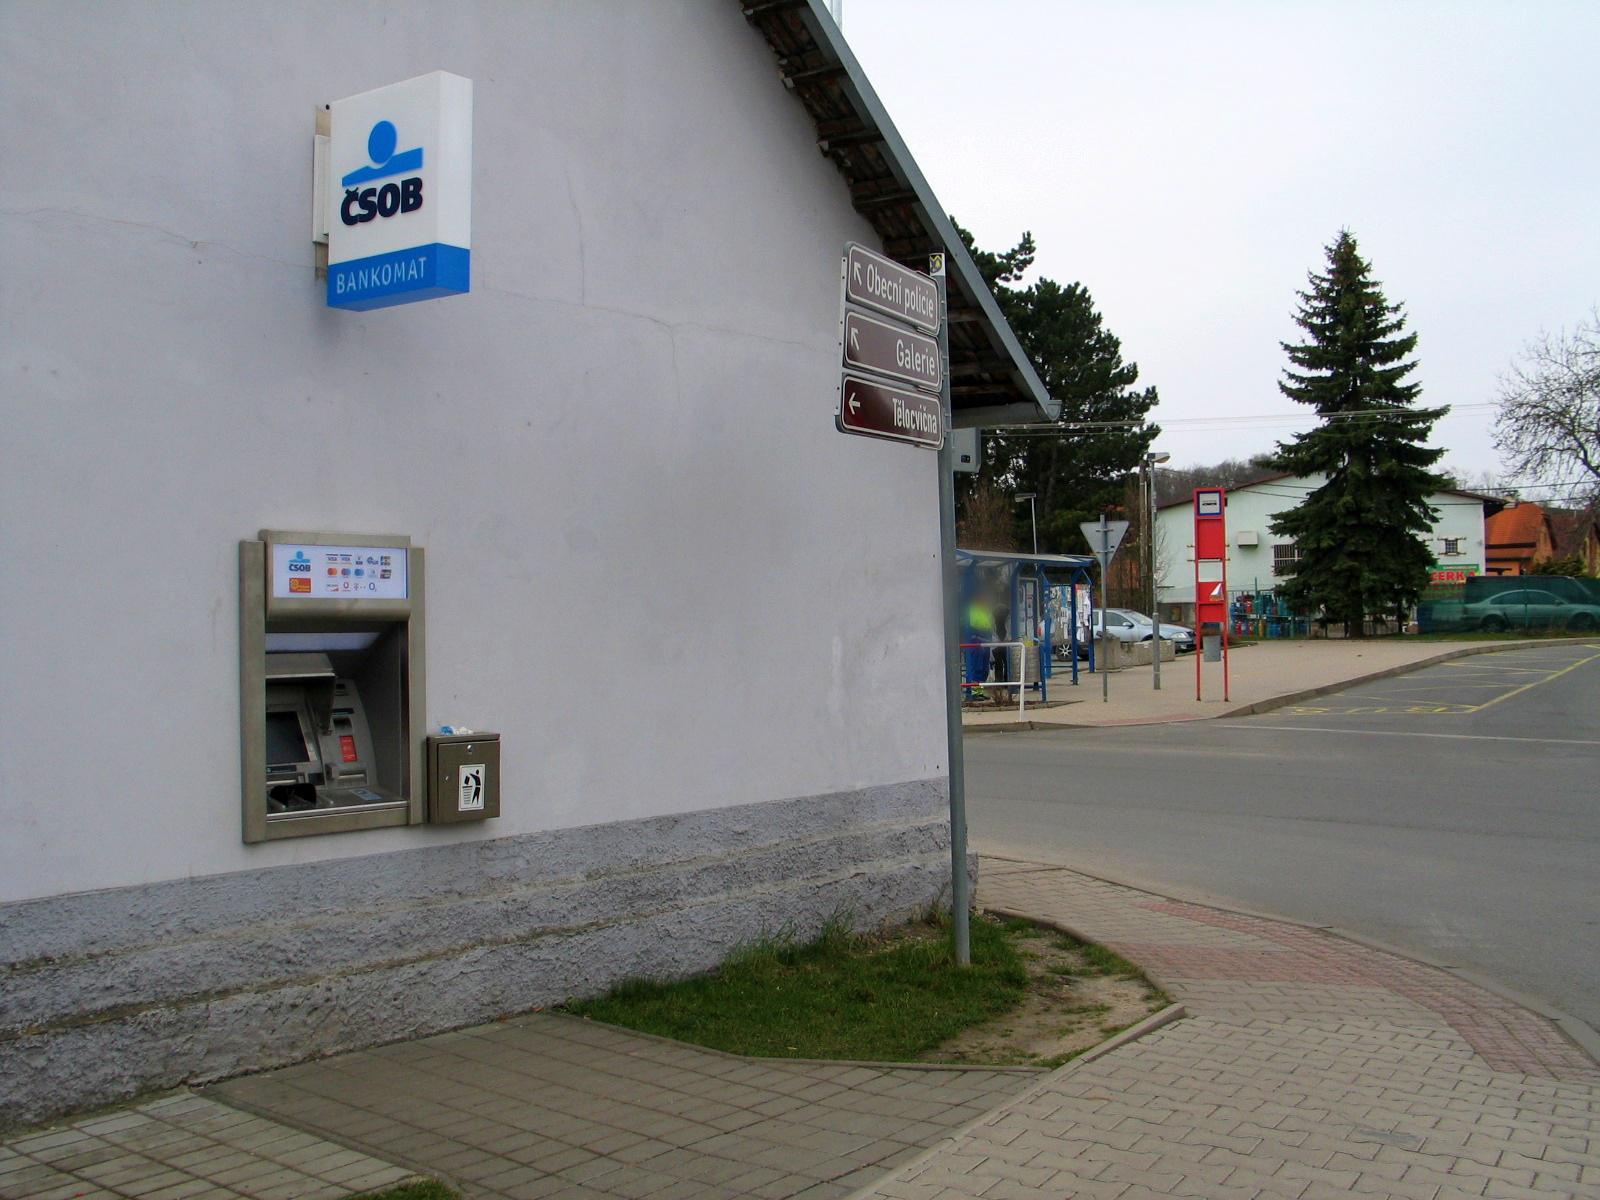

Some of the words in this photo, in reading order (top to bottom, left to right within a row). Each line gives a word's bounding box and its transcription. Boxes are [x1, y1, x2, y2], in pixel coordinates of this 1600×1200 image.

[340, 176, 424, 226] ČSOB
[336, 256, 427, 294] BANKOMAT
[866, 262, 902, 305] Obecní
[904, 286, 935, 319] policie
[896, 338, 935, 376] Galerie
[892, 397, 938, 434] Tělocvična
